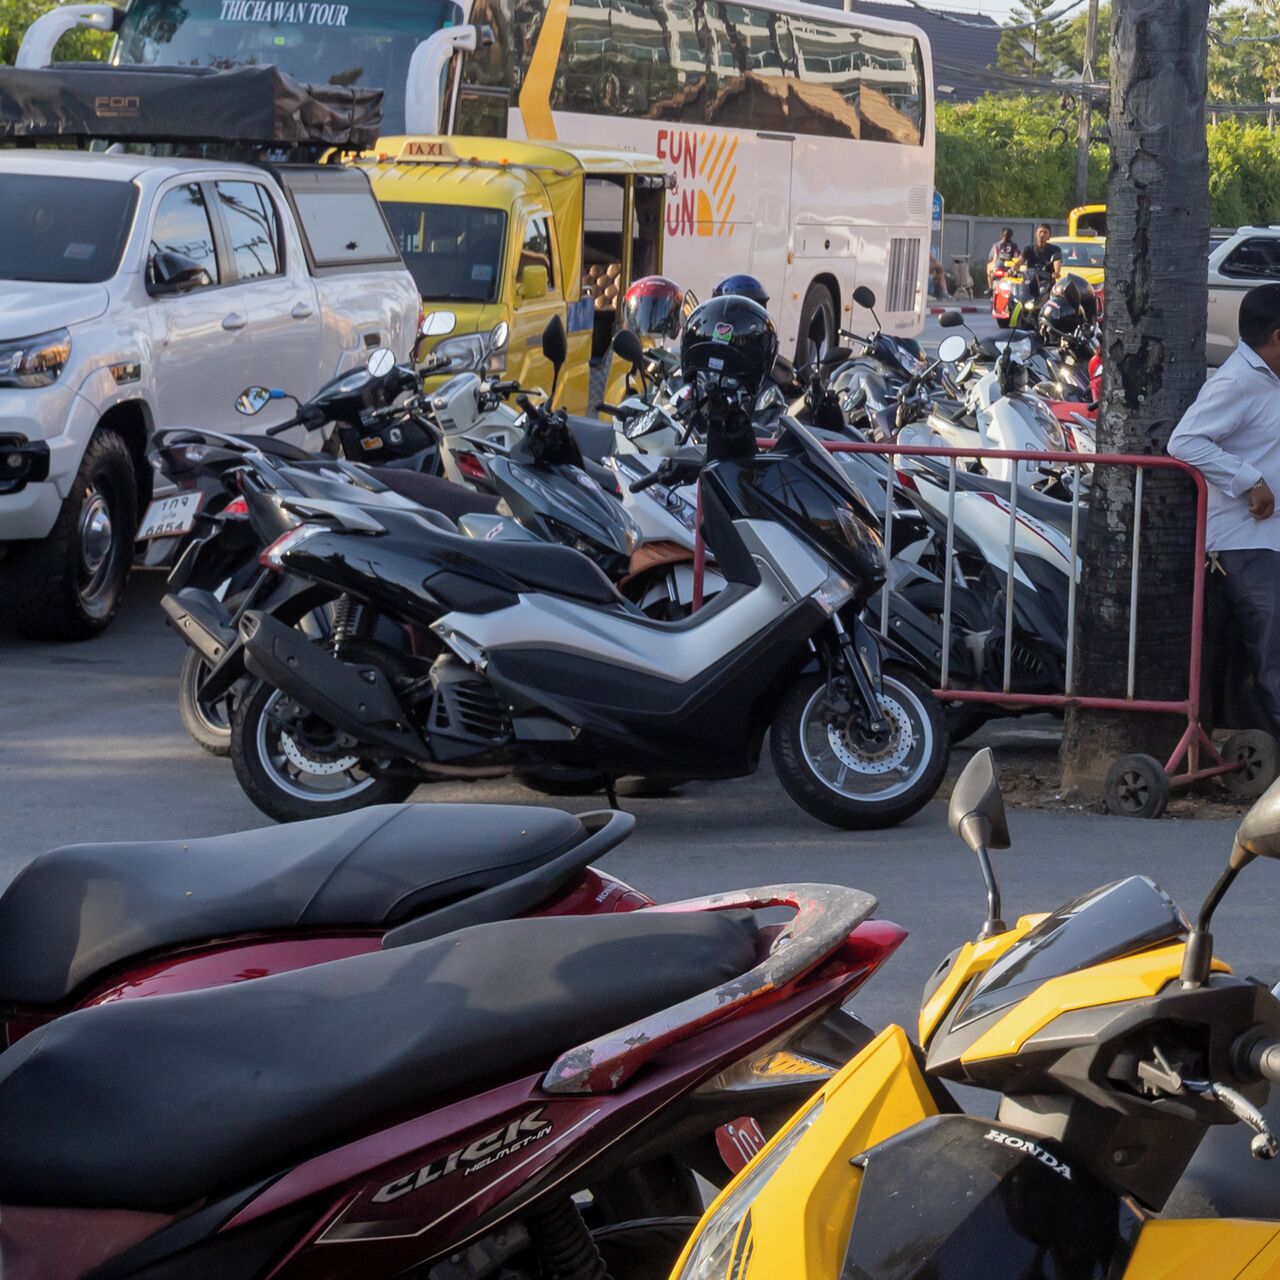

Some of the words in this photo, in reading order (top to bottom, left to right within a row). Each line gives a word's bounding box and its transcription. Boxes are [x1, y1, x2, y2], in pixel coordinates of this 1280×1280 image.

[220, 0, 307, 24] THICHAWAN
[308, 2, 349, 26] TOUR
[407, 143, 443, 155] TAXI
[666, 189, 695, 237] UN
[370, 1107, 549, 1204] CLICK
[983, 1128, 1072, 1181] HONDA
